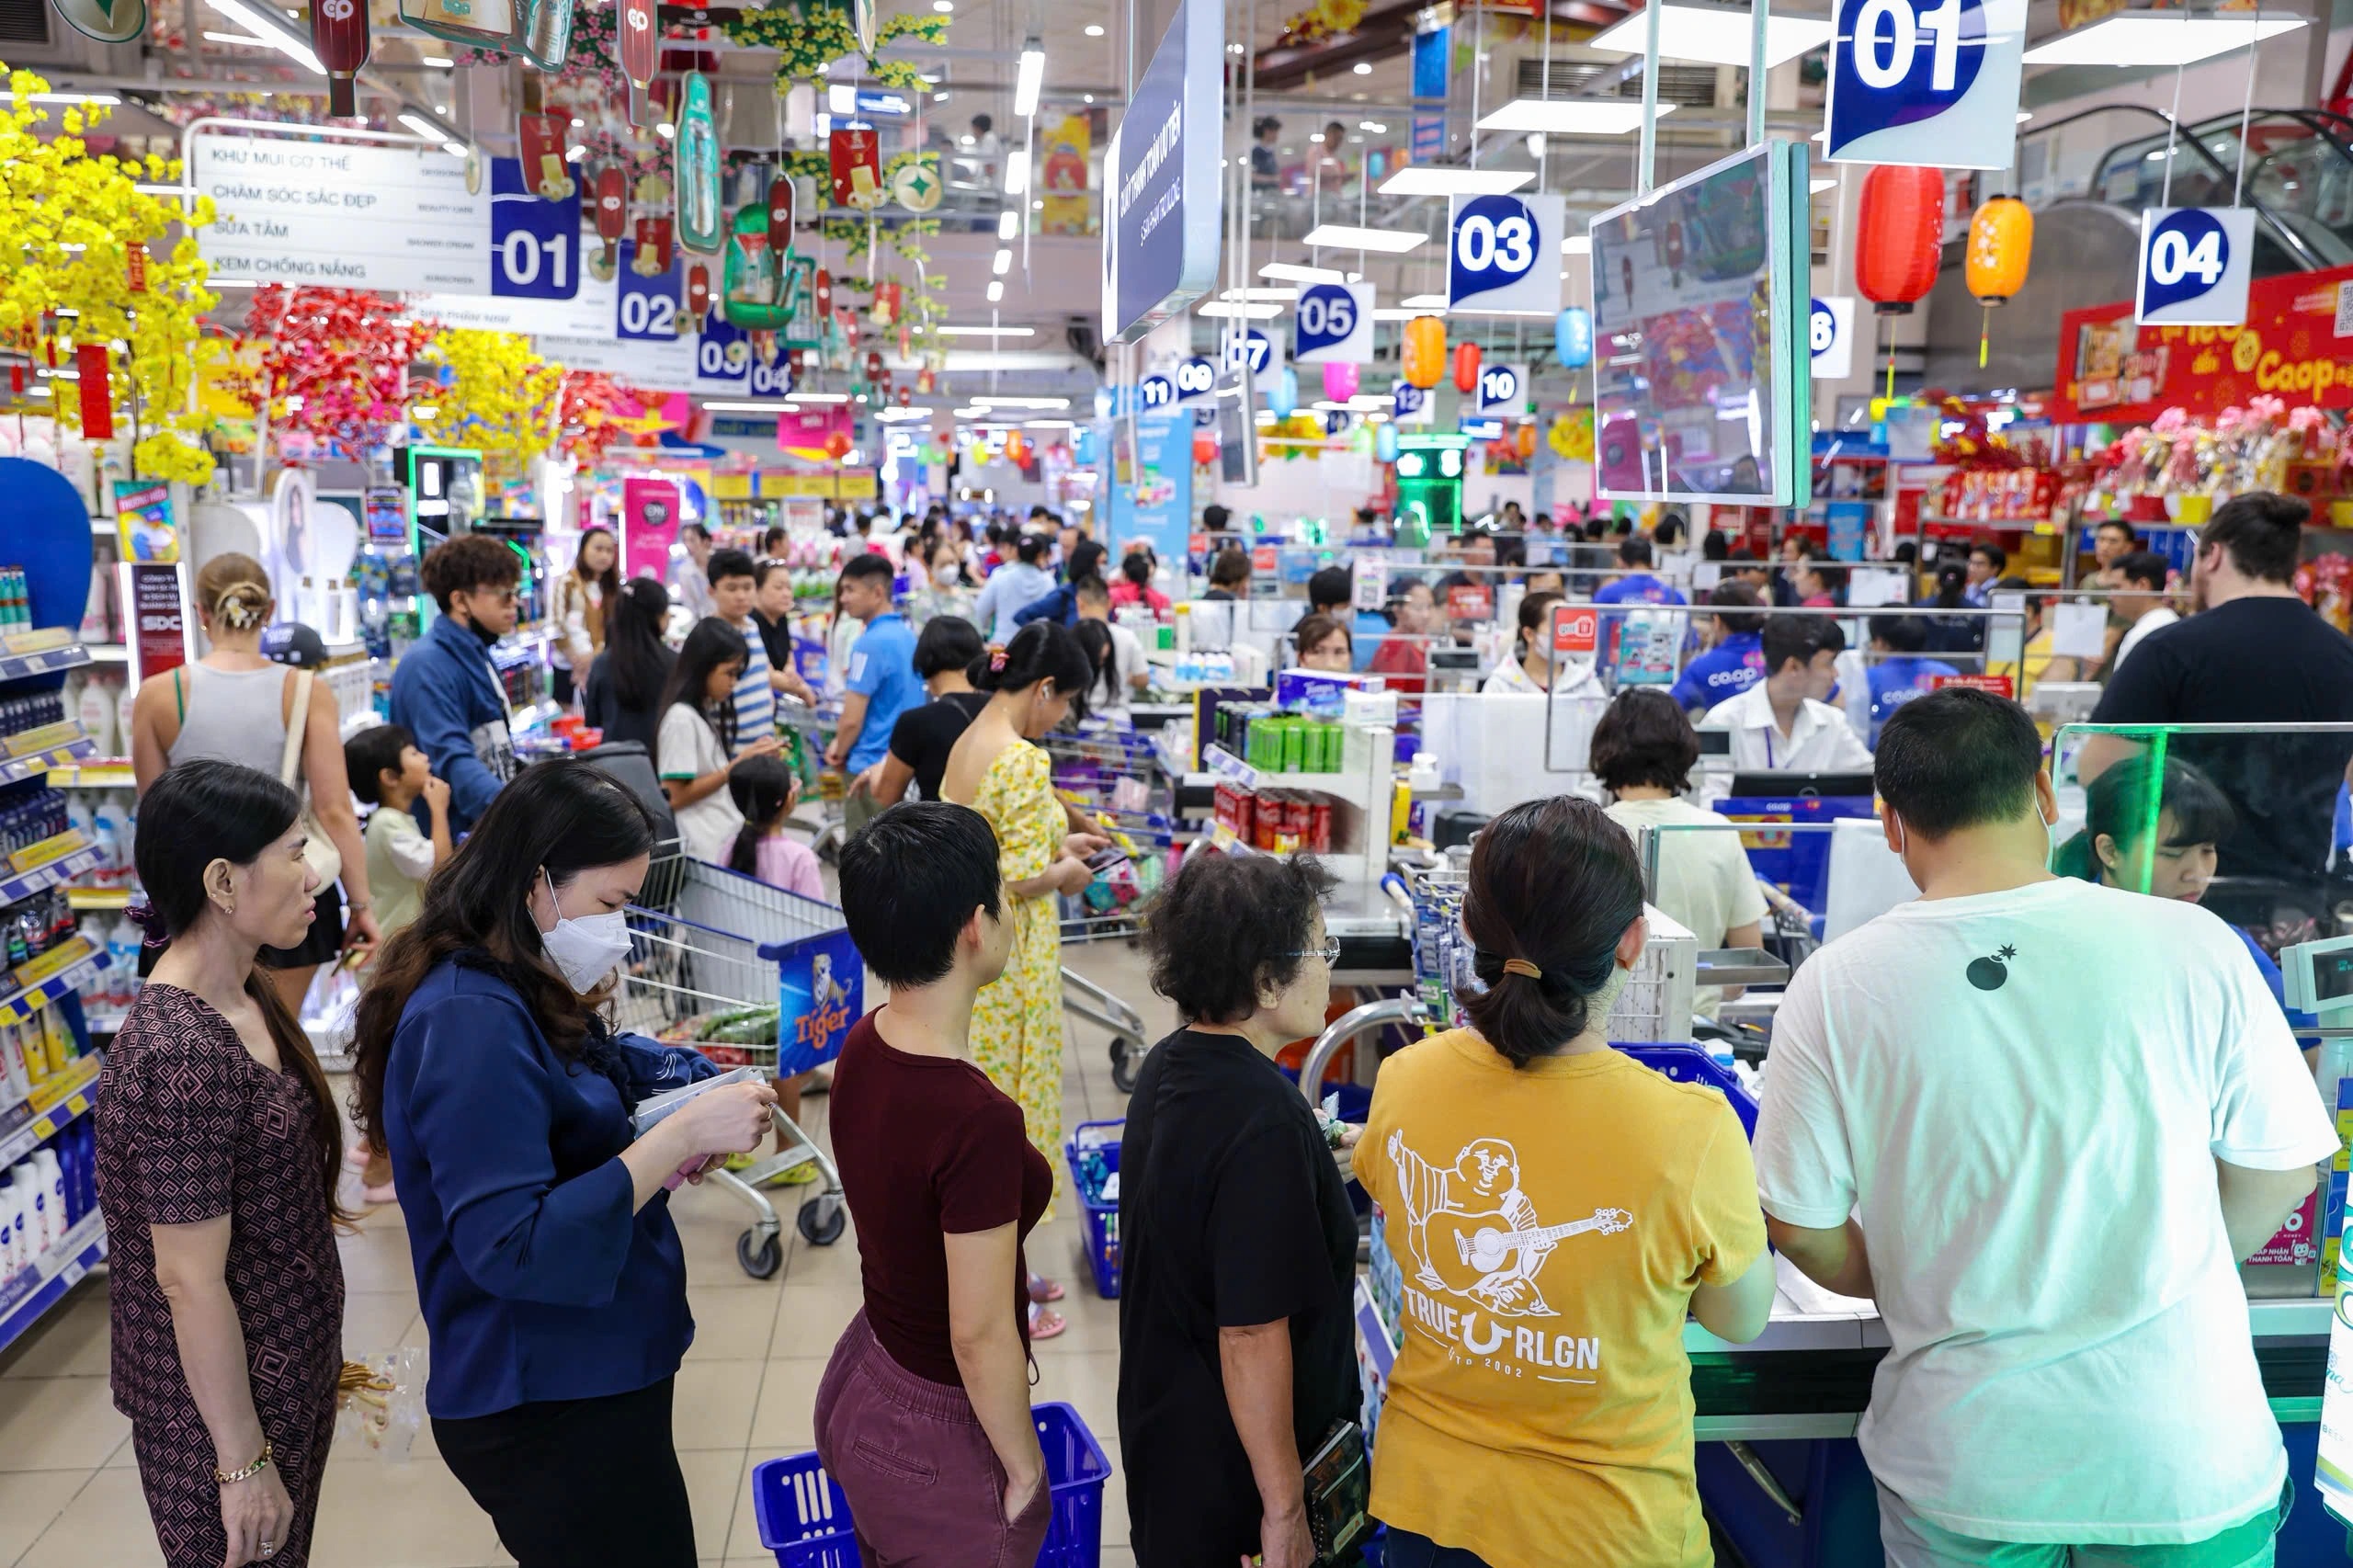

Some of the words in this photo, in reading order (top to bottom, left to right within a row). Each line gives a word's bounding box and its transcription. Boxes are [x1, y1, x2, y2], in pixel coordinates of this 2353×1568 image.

[1854, 0, 1961, 90] 01
[213, 256, 250, 271] KEM
[503, 230, 567, 288] 01
[1457, 214, 1533, 273] 03
[2151, 230, 2223, 285] 04
[621, 292, 676, 335] 02
[1301, 296, 1357, 337] 05
[754, 363, 791, 392] 04
[1143, 381, 1168, 404] 11
[1483, 372, 1516, 400] 10
[1397, 390, 1424, 410] 12
[794, 1003, 851, 1050] Tiger
[2248, 1256, 2273, 1264] THANH
[2274, 1254, 2293, 1263] TOÁN
[1404, 1284, 1460, 1341] TRUE
[1516, 1325, 1598, 1370] RLGN
[1484, 1358, 1522, 1378] 2002
